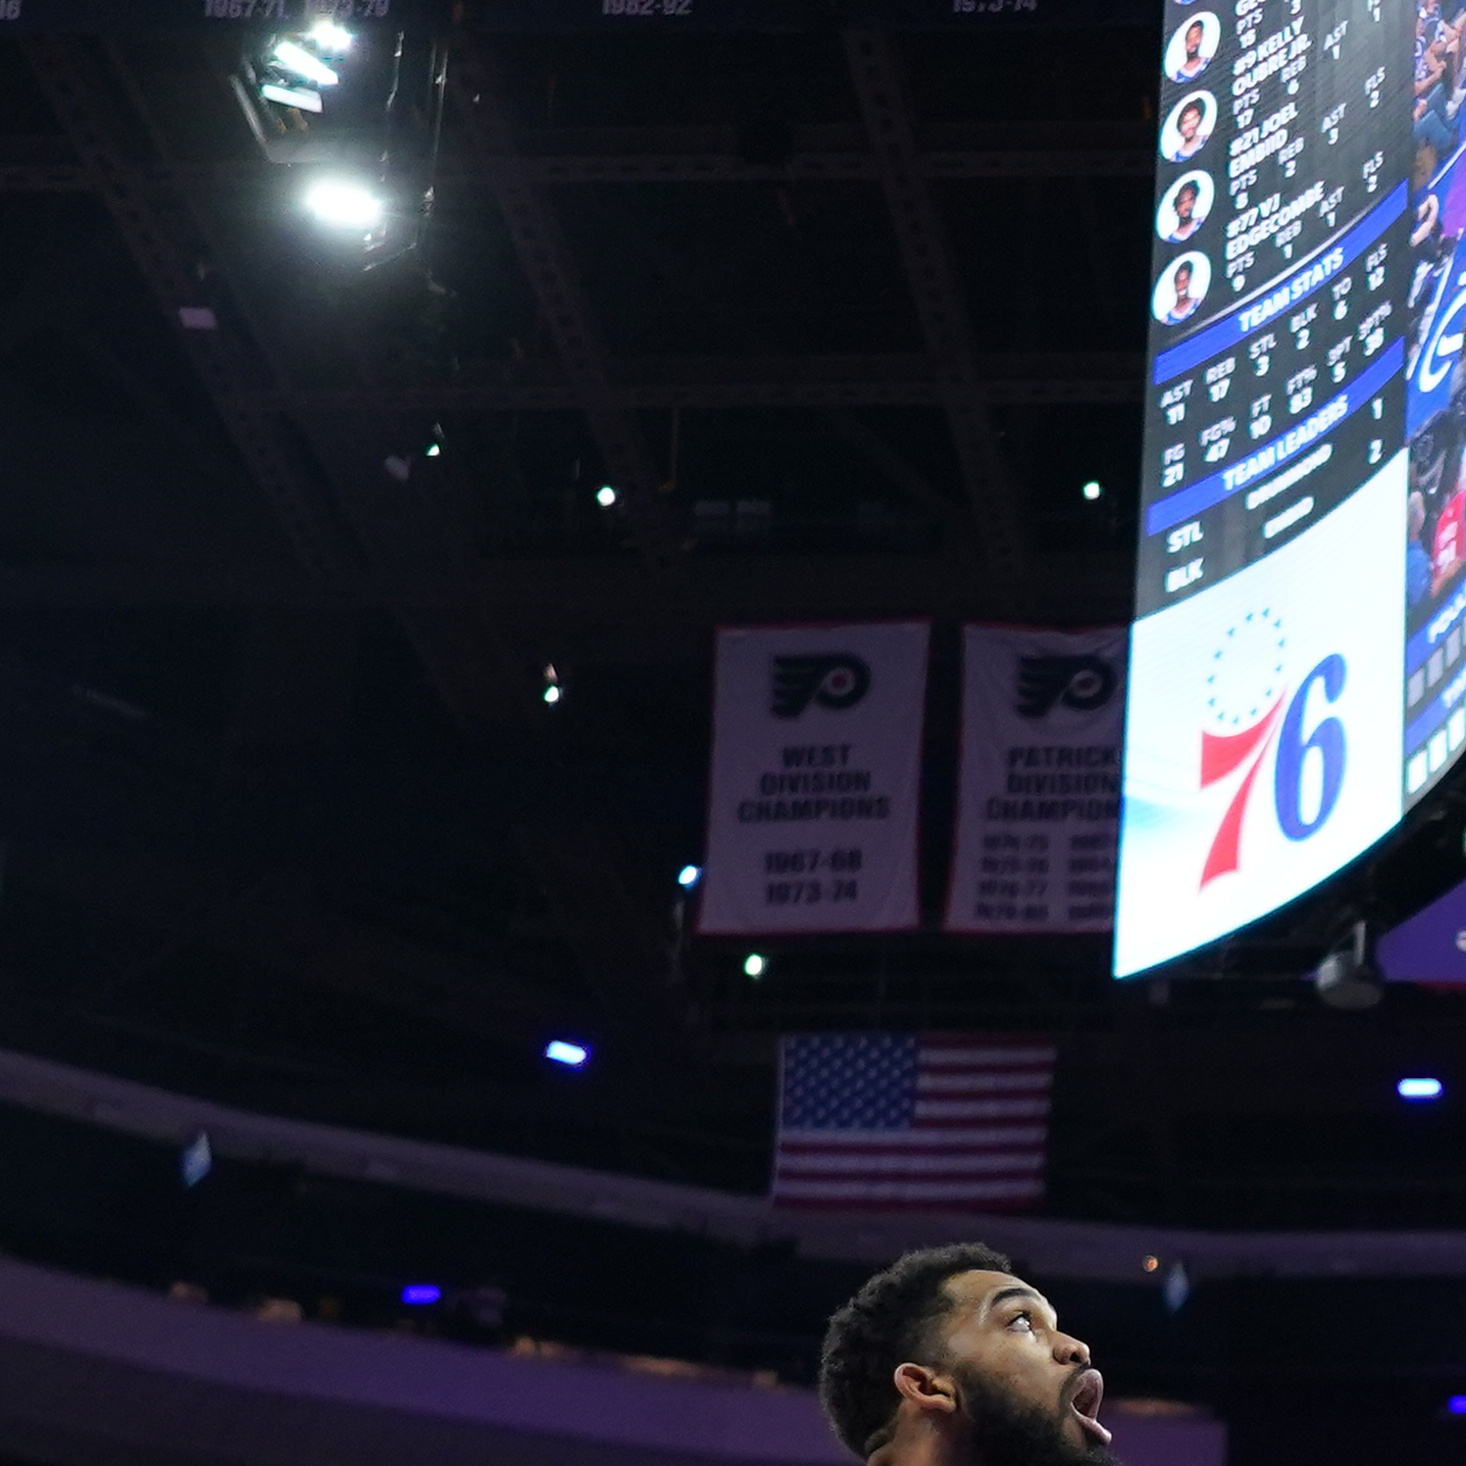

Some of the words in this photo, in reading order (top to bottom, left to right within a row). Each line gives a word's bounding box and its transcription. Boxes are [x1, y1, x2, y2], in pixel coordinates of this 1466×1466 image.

[1257, 15, 1305, 62] KELLY
[1324, 20, 1349, 51] AST
[1231, 47, 1289, 97] OUBRE
[1260, 102, 1300, 139] JOEL
[1320, 102, 1348, 134] AST
[1227, 128, 1289, 179] EMBIID
[1225, 179, 1326, 261] EDGECOMBE
[1239, 286, 1291, 333] TEAM
[1290, 246, 1345, 301] STATS
[1160, 380, 1193, 409] AST
[1204, 357, 1236, 385] REB
[1247, 333, 1277, 361] STL
[1288, 302, 1320, 333] BLK
[1332, 277, 1353, 301] TO
[1364, 244, 1388, 273] FLS
[1249, 393, 1274, 419] FT
[1220, 445, 1276, 492] TEAM
[1275, 393, 1350, 462] LEADERS
[1167, 520, 1205, 554] STL
[1370, 397, 1384, 421] 1
[1165, 557, 1204, 592] BLK
[1368, 438, 1384, 465] 2
[783, 745, 851, 767] WEST
[1199, 652, 1348, 897] 76
[760, 772, 871, 796] DIVISION
[738, 796, 890, 822] CHAMPIONS
[985, 798, 1121, 821] CHAMPION
